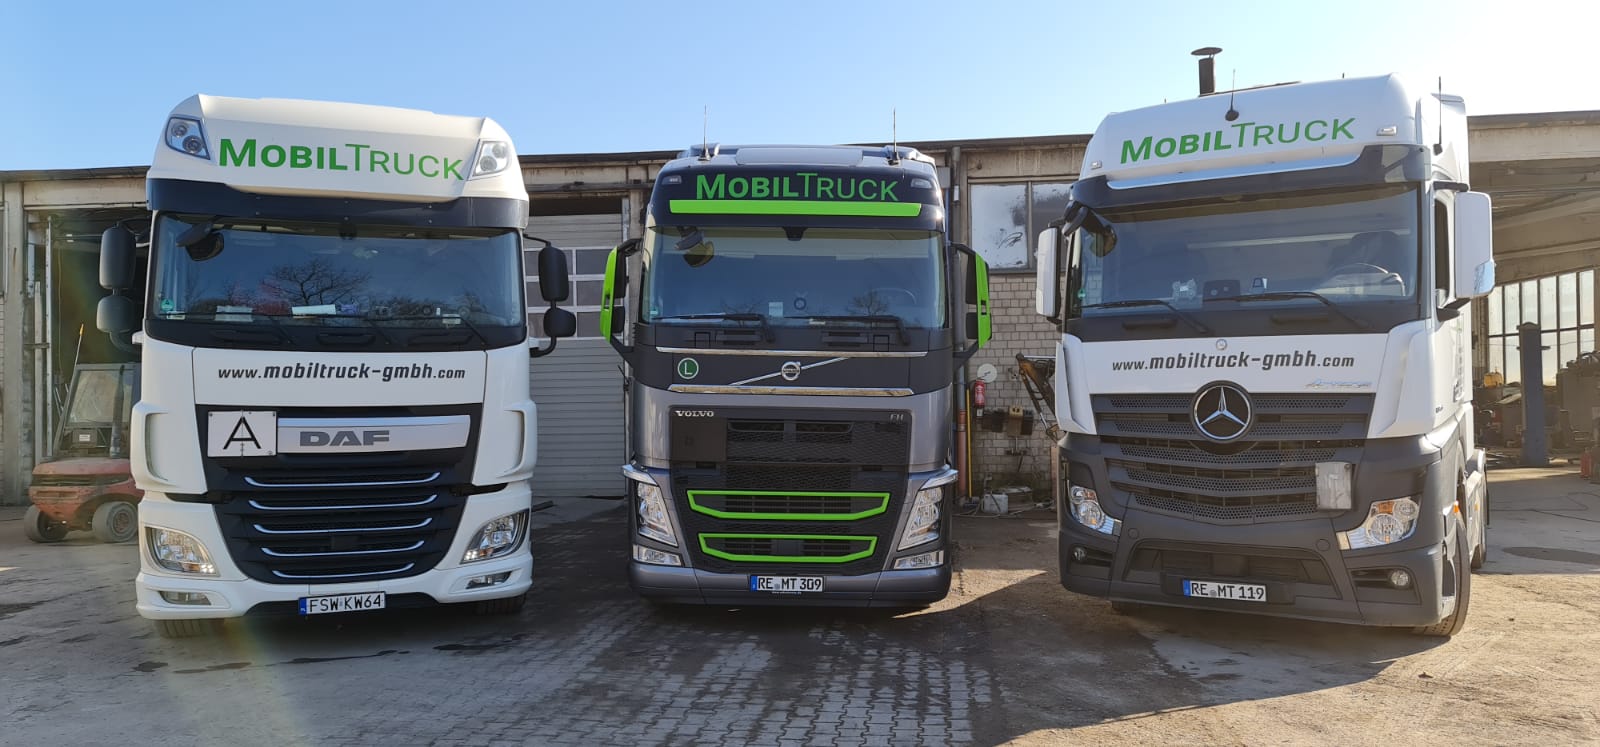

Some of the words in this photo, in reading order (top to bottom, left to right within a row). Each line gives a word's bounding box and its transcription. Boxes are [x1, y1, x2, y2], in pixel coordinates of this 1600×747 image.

[684, 362, 693, 375] L
[1112, 350, 1355, 371] www.mobiltruck-gmbh.com
[218, 362, 466, 383] www.mobiltruck-gmbh.com
[675, 410, 715, 418] VOLVO
[223, 416, 262, 450] A
[299, 430, 390, 447] DAF
[758, 577, 774, 590] RE
[781, 578, 798, 590] MT
[799, 578, 822, 591] 309
[1191, 582, 1209, 596] RE
[1217, 584, 1235, 598] MT
[1238, 586, 1265, 600] 119
[309, 597, 339, 613] FSW
[344, 594, 381, 610] KW64
